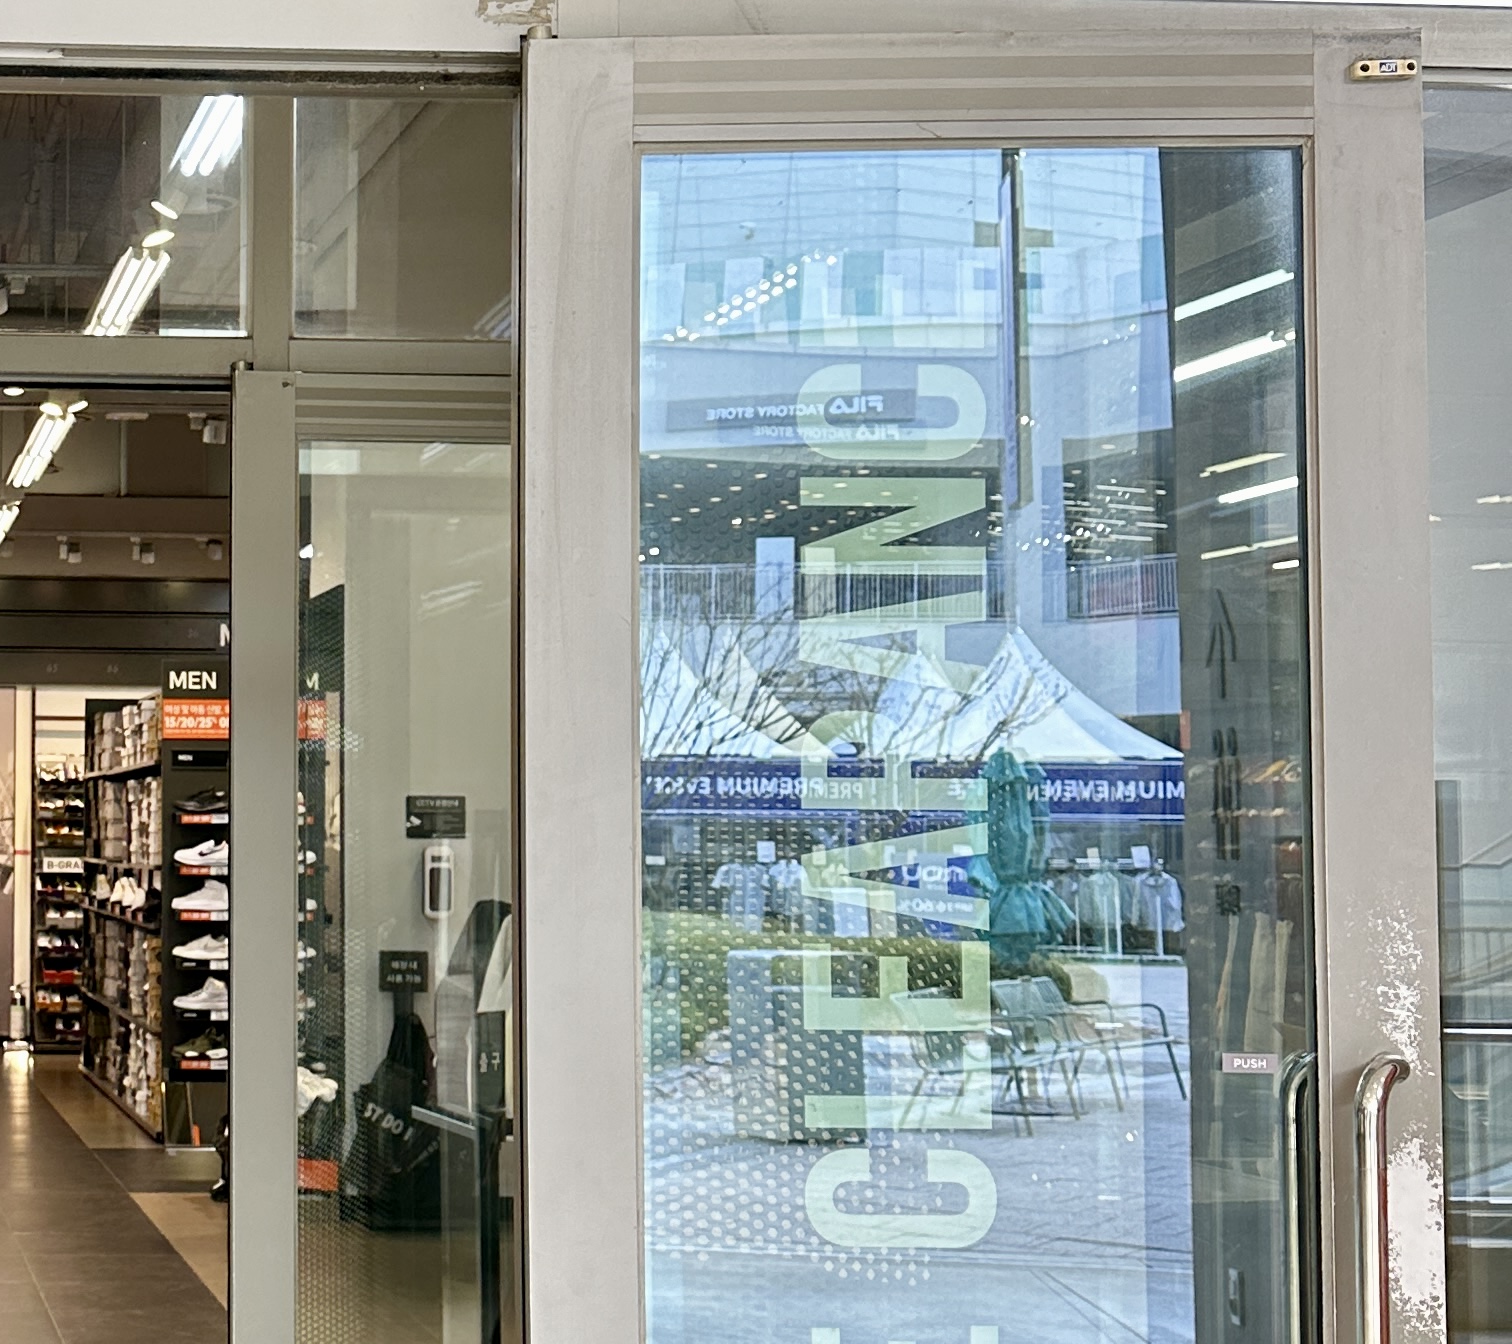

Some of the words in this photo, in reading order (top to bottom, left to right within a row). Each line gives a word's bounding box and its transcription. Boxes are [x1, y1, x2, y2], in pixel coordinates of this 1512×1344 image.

[1380, 62, 1397, 73] ADT
[168, 670, 217, 690] MEN
[797, 258, 998, 1249] CLEARANCE
[46, 860, 82, 870] B-GRA
[479, 1052, 501, 1073] 출구
[1233, 1057, 1267, 1069] PUSH
[380, 1110, 405, 1136] DO
